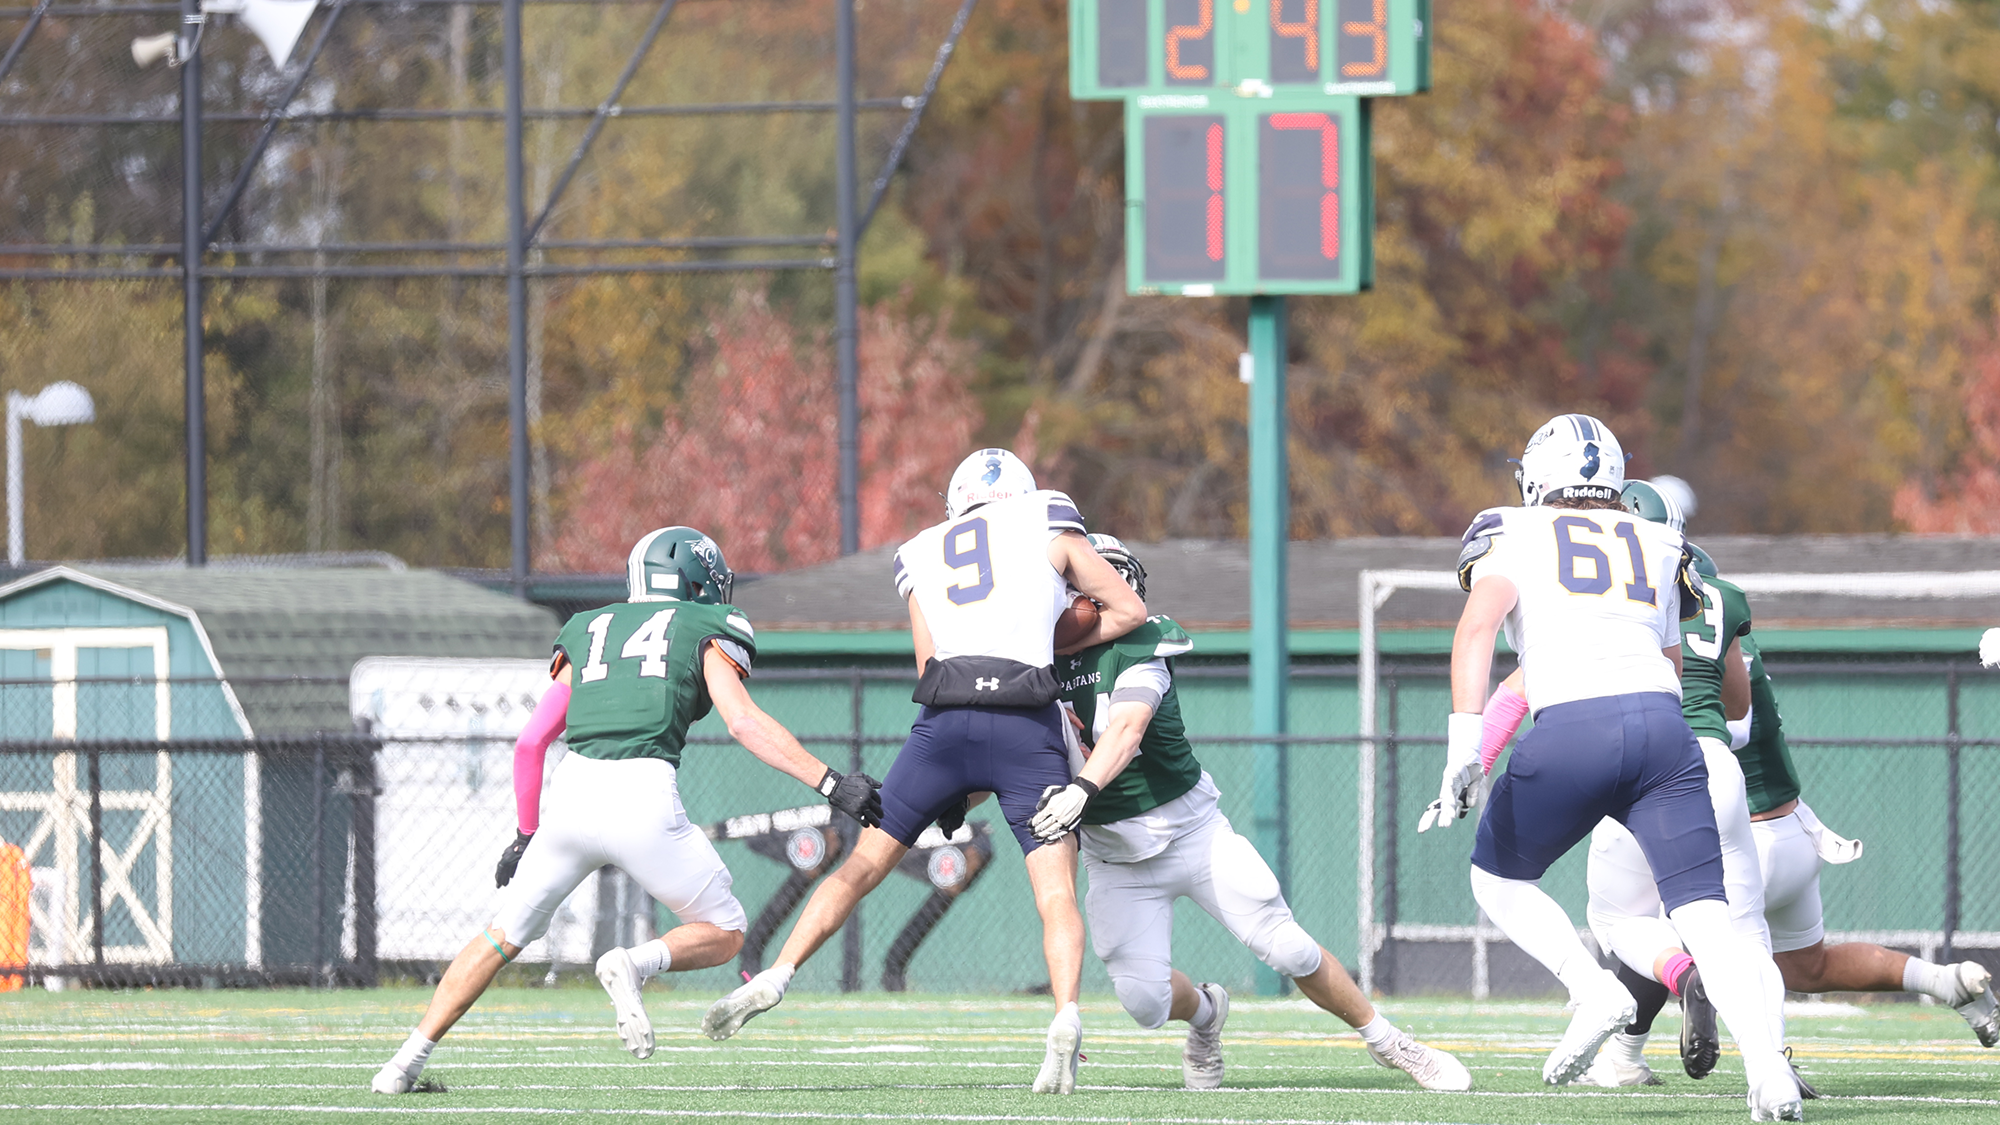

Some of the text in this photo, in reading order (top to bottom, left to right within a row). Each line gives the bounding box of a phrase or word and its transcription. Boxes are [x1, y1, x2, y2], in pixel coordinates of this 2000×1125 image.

[1563, 487, 1612, 500] Riddell
[944, 517, 994, 606] 9
[1553, 515, 1658, 610] 61
[580, 608, 677, 684] 14
[1060, 671, 1102, 692] PARTANS
